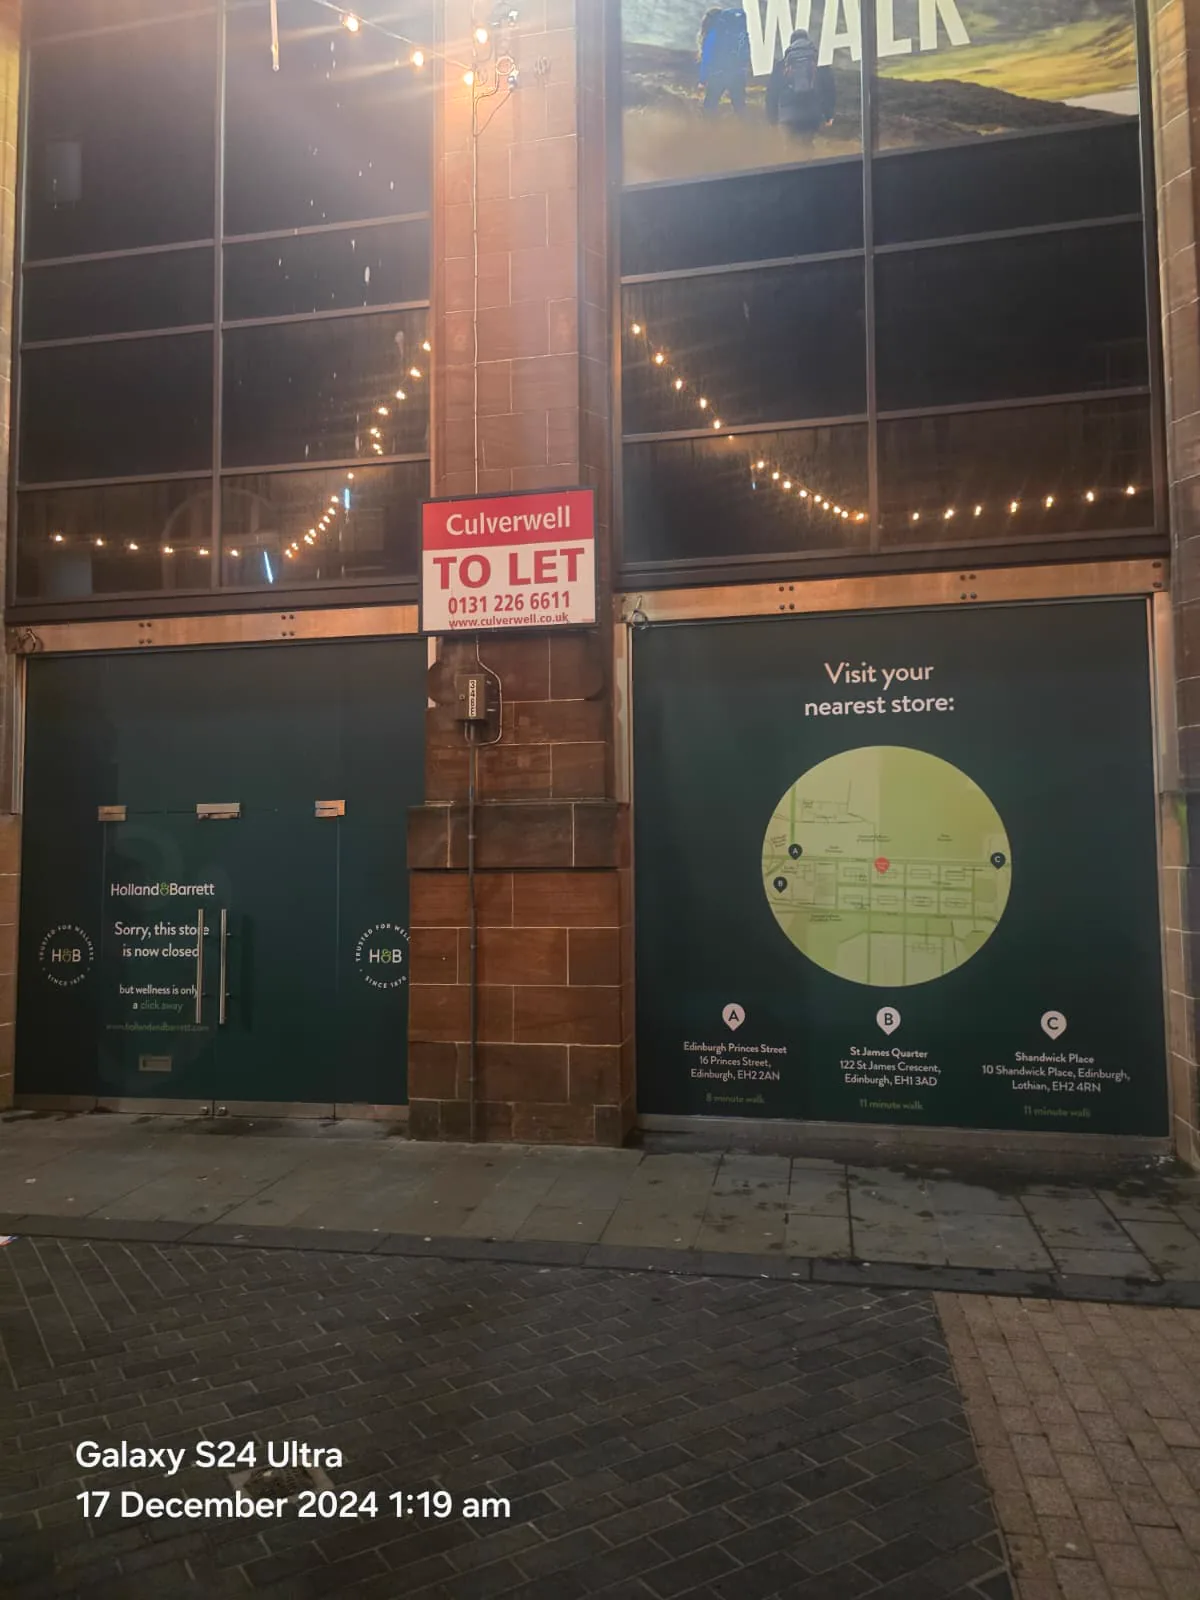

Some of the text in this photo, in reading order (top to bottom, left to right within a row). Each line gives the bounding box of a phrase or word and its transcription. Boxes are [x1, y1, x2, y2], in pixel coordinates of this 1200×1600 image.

[446, 505, 570, 536] Culverwell
[433, 548, 585, 590] TO LET
[448, 591, 570, 615] 0131 226 6611
[449, 612, 569, 628] www.culverwell.co.uk
[824, 661, 935, 691] Visit your
[804, 695, 955, 716] nearest store:
[110, 882, 216, 897] Holland&Barrett
[114, 921, 210, 941] Sorry, this stoe
[375, 923, 391, 931] FOR
[51, 948, 81, 963] H&B
[122, 943, 200, 957] is now closed
[369, 948, 402, 964] H&B
[365, 975, 387, 988] SINCE
[119, 983, 198, 998] but wellness is only
[132, 1000, 184, 1013] a click away
[728, 1009, 740, 1021] A
[884, 1012, 894, 1025] B
[1047, 1016, 1059, 1030] C
[683, 1041, 787, 1055] Edinburgh Princes Street
[850, 1046, 928, 1059] St James Quarter
[700, 1056, 772, 1068] 16 Princes Street,
[1015, 1051, 1095, 1064] Shandwick Place
[840, 1060, 942, 1074] 122 St James Crescent,
[982, 1064, 1131, 1082] 10 Shandwick Place, Edinburgh,
[690, 1069, 780, 1082] Edinburgh, EH2 2AN
[844, 1073, 938, 1087] Edinburgh, EH1 3AD
[1012, 1080, 1102, 1093] Lothian, EH2 4RN
[869, 1099, 901, 1109] minute
[902, 1100, 923, 1110] walk
[1034, 1106, 1068, 1117] minute
